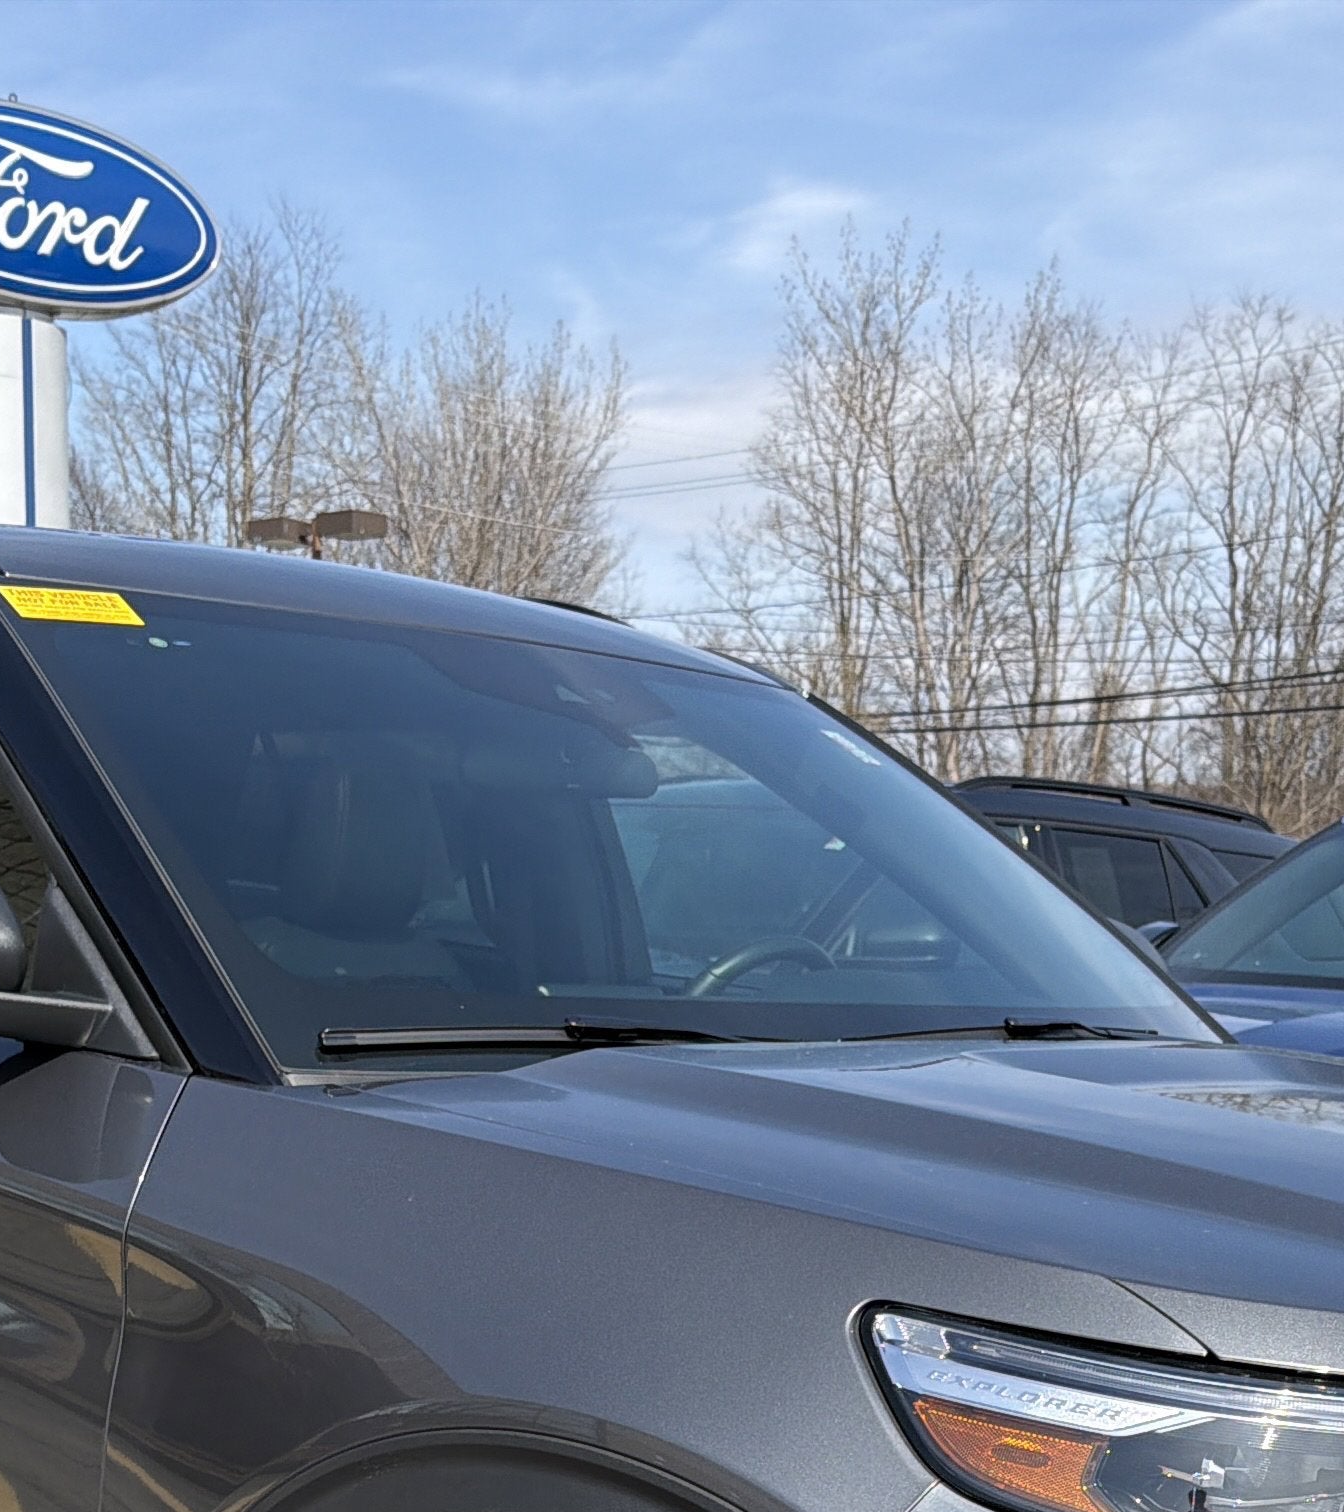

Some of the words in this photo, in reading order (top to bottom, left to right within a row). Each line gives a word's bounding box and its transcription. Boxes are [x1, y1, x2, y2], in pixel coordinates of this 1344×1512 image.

[4, 588, 45, 599] THIS
[47, 591, 119, 604] VEHICLE
[16, 597, 46, 605] NOT
[83, 600, 121, 610] SALE
[926, 1368, 1124, 1422] EXPLORER
